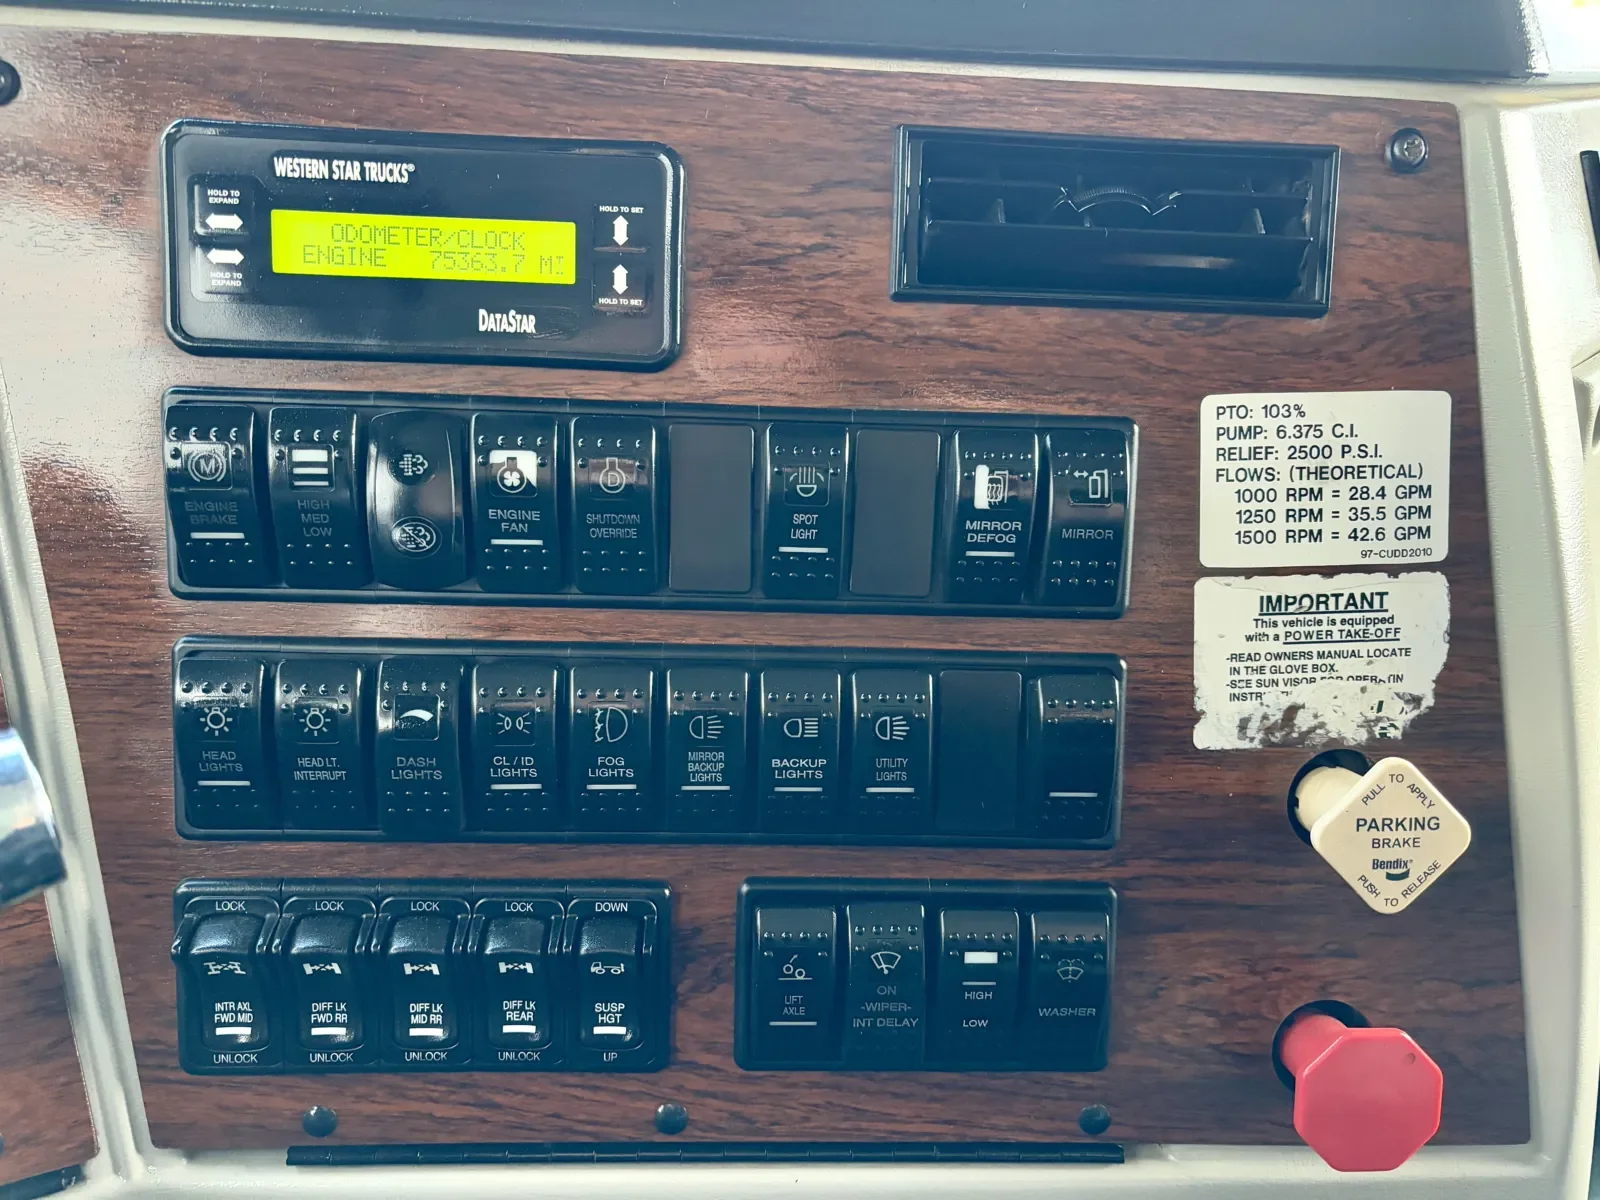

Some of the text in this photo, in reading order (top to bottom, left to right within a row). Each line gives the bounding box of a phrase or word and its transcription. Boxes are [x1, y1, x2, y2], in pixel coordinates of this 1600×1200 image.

[273, 156, 329, 180] WESTERN
[332, 159, 362, 181] STAR
[207, 189, 228, 197] HOLD
[208, 197, 240, 205] EXPAND
[599, 205, 619, 213] HOLD
[331, 223, 525, 250] ODOMETER/CLOCK
[303, 245, 564, 276] ENGINE 75363.7 MI
[211, 279, 242, 287] EXPAND
[1216, 403, 1306, 420] PTO: 103%
[1216, 423, 1359, 441] PUMP: 6.375 C.I.
[1216, 443, 1383, 462] RELIEF: 2500 P.S.I.
[1215, 462, 1424, 483] FLOWS: (THEORETICAL)
[1234, 484, 1432, 503] 1000 RPM = 28.4 GPM
[184, 501, 239, 512] ENGINE
[297, 499, 330, 511] HIGH
[190, 514, 238, 525] BRAKE
[301, 513, 330, 524] MED
[488, 509, 541, 522] ENGINE
[585, 513, 641, 525] SHUTDOWN
[792, 513, 818, 526] SPOT
[1235, 505, 1432, 524] 1250 RPM = 35.5 GPM
[303, 526, 332, 538] LOW
[501, 521, 529, 533] FAN
[965, 520, 1022, 532] MIRROR
[589, 526, 638, 539] OVERRIDE
[790, 528, 818, 541] LIGHT
[966, 532, 1017, 545] DEFOG
[1062, 528, 1114, 540] MIRROR
[1234, 526, 1431, 545] 1500 RPM = 42.6 GPM
[1360, 547, 1433, 559] 97-CUDD2010
[1259, 591, 1389, 613] IMPORTANT
[1253, 614, 1395, 629] This vehicle is equipped
[1245, 627, 1401, 642] with a POWER TAKE-OFF
[1225, 647, 1412, 663] -READ OWNERS MANUAL LOCATE
[1229, 663, 1339, 676] IN THE GLOVE BOX.
[1255, 678, 1279, 688] SUN
[202, 751, 237, 761] HEAD
[297, 756, 340, 768] HEAD LT.
[396, 756, 437, 768] DASH
[492, 756, 511, 767] CL
[521, 756, 534, 767] ID
[597, 756, 625, 767] FOG
[688, 751, 725, 762] MIRROR
[199, 762, 243, 772] LIGHTS
[687, 761, 725, 773] BACKUP
[771, 758, 827, 769] BACKUP
[875, 758, 909, 769] UTILITY
[293, 770, 347, 782] INTERRUPT
[391, 769, 443, 781] LIGHTS
[490, 767, 538, 778] LIGHTS
[588, 767, 635, 779] LIGHTS
[689, 772, 723, 783] LIGHTS
[774, 769, 823, 780] LIGHTS
[875, 770, 908, 782] LIGHTS
[1361, 773, 1436, 810] PULL TO APPLY
[1356, 816, 1440, 832] PARKING
[1371, 837, 1421, 849] BRAKE
[1357, 860, 1442, 907] PUSH TO RELEASE
[215, 900, 246, 912] LOCK
[315, 900, 344, 912] LOCK
[410, 900, 440, 912] LOCK
[504, 901, 534, 913] LOCK
[594, 901, 628, 913] DOWN
[877, 985, 897, 996] ON
[964, 991, 993, 1000] HIGH
[503, 1000, 536, 1011] DIFF LK
[784, 995, 803, 1005] LIFT
[214, 1001, 253, 1013] INTR AXL
[311, 1002, 347, 1013] DIFF LK
[409, 1003, 443, 1014] DIFF LK
[594, 1003, 625, 1014] SUSP
[782, 1006, 805, 1016] AXLE
[1038, 1007, 1096, 1017] WASHER
[214, 1012, 254, 1024] FWD MID
[310, 1012, 348, 1024] FWD RR
[410, 1013, 442, 1025] MID RR
[505, 1010, 534, 1022] REAR
[598, 1012, 622, 1024] HGT
[853, 1017, 919, 1028] INT DELAY
[962, 1019, 989, 1028] LOW
[213, 1053, 258, 1064] UNLOCK
[309, 1052, 354, 1063] UNLOCK
[405, 1051, 448, 1062] UNLOCK
[498, 1051, 541, 1062] UNLOCK
[603, 1051, 618, 1063] UP
